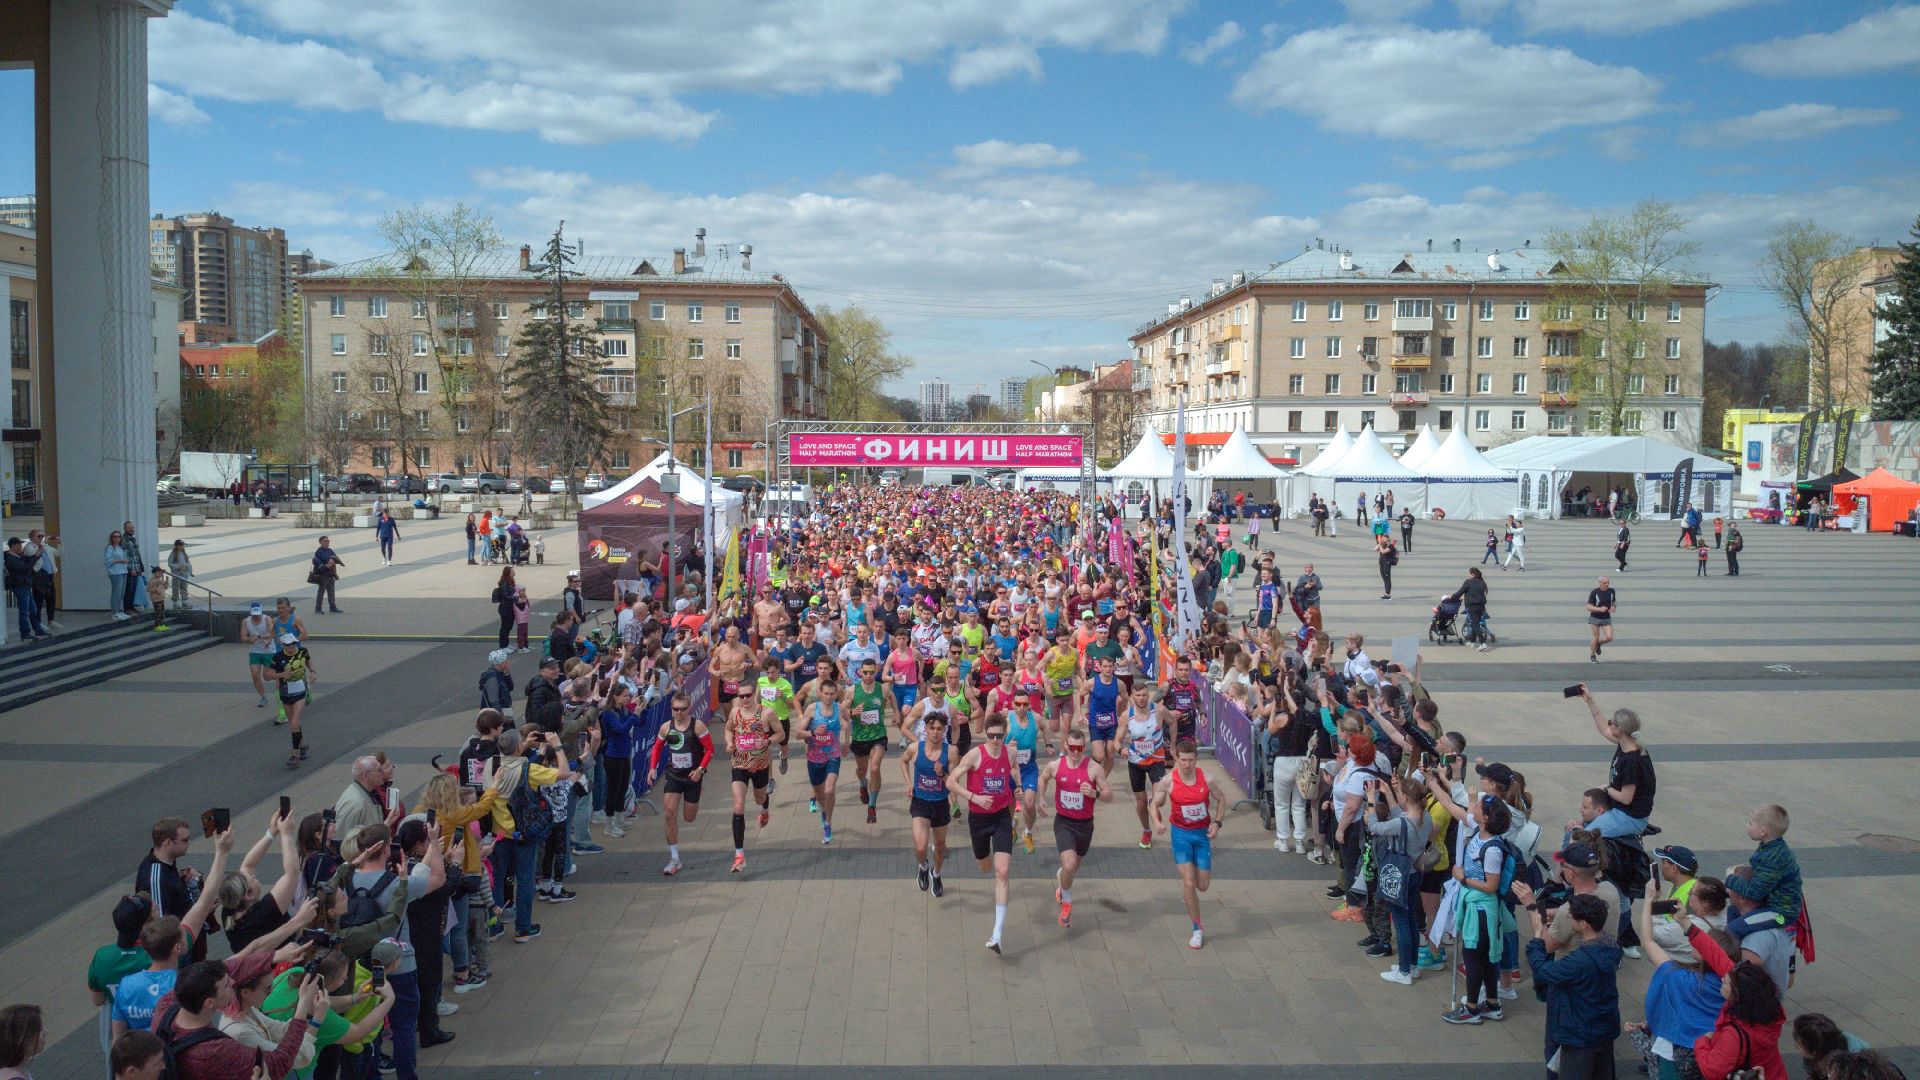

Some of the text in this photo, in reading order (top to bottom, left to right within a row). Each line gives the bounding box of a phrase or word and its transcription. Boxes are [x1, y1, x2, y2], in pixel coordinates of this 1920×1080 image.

[864, 439, 1008, 461] ФИНИШ
[1800, 419, 1812, 476] POWERUP
[1834, 418, 1849, 476] POWERUP
[128, 1005, 155, 1019] Цик
